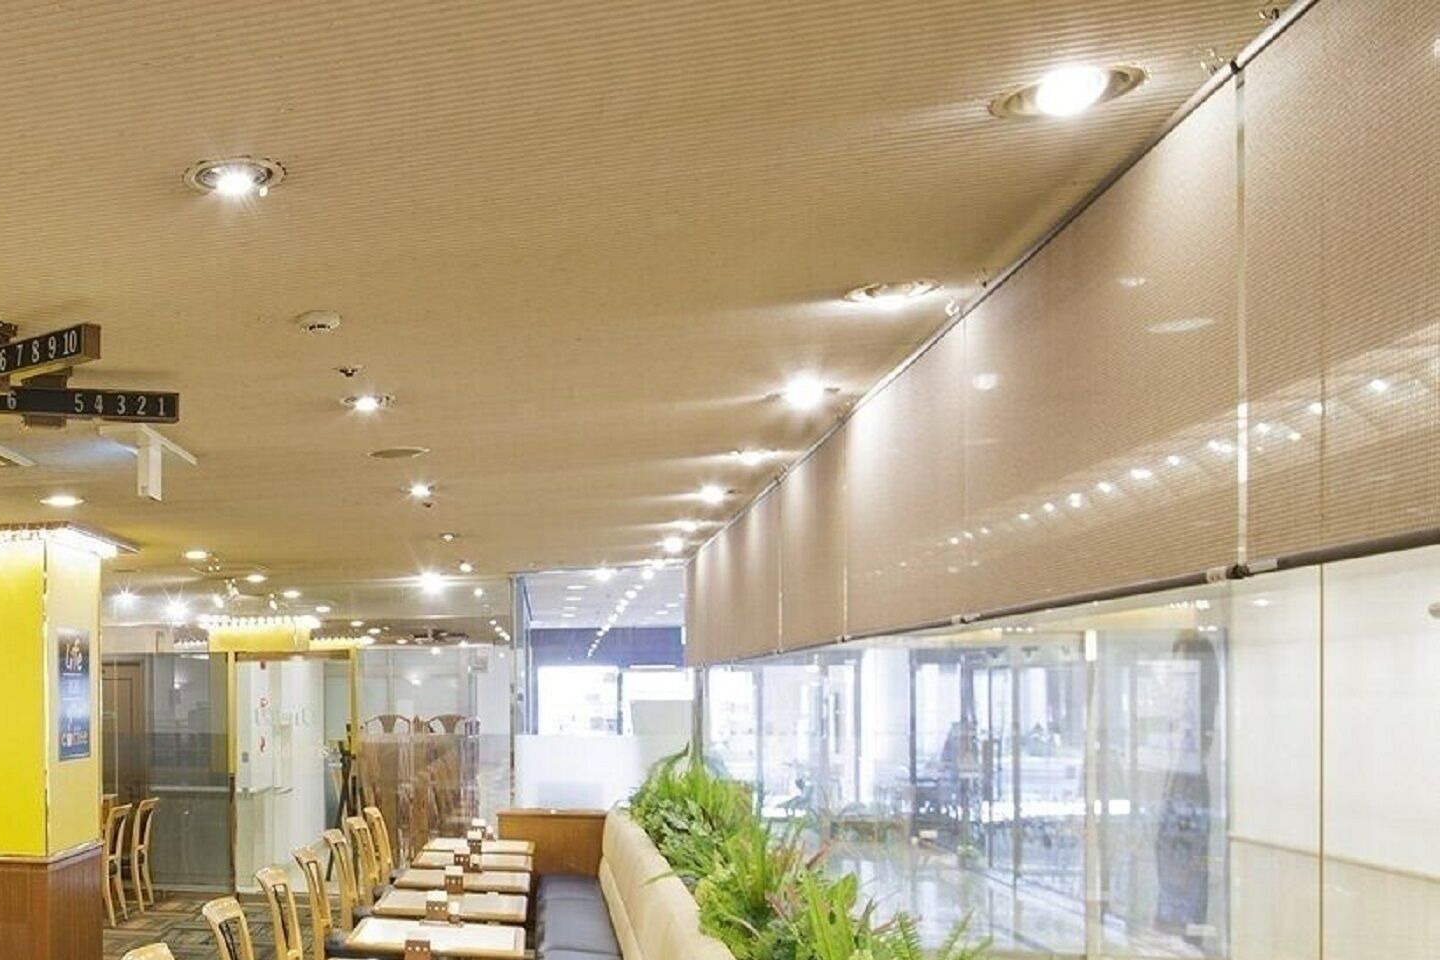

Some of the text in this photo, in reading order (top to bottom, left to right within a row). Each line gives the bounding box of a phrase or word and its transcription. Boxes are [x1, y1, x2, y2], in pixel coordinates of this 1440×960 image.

[0, 348, 7, 371] 6
[16, 344, 24, 366] 7
[31, 340, 40, 363] 8
[48, 336, 57, 359] 9
[62, 330, 78, 355] 10
[74, 393, 84, 413] 5
[93, 395, 103, 414] 4
[117, 394, 126, 415] 3
[136, 395, 146, 415] 2
[159, 397, 166, 416] 1
